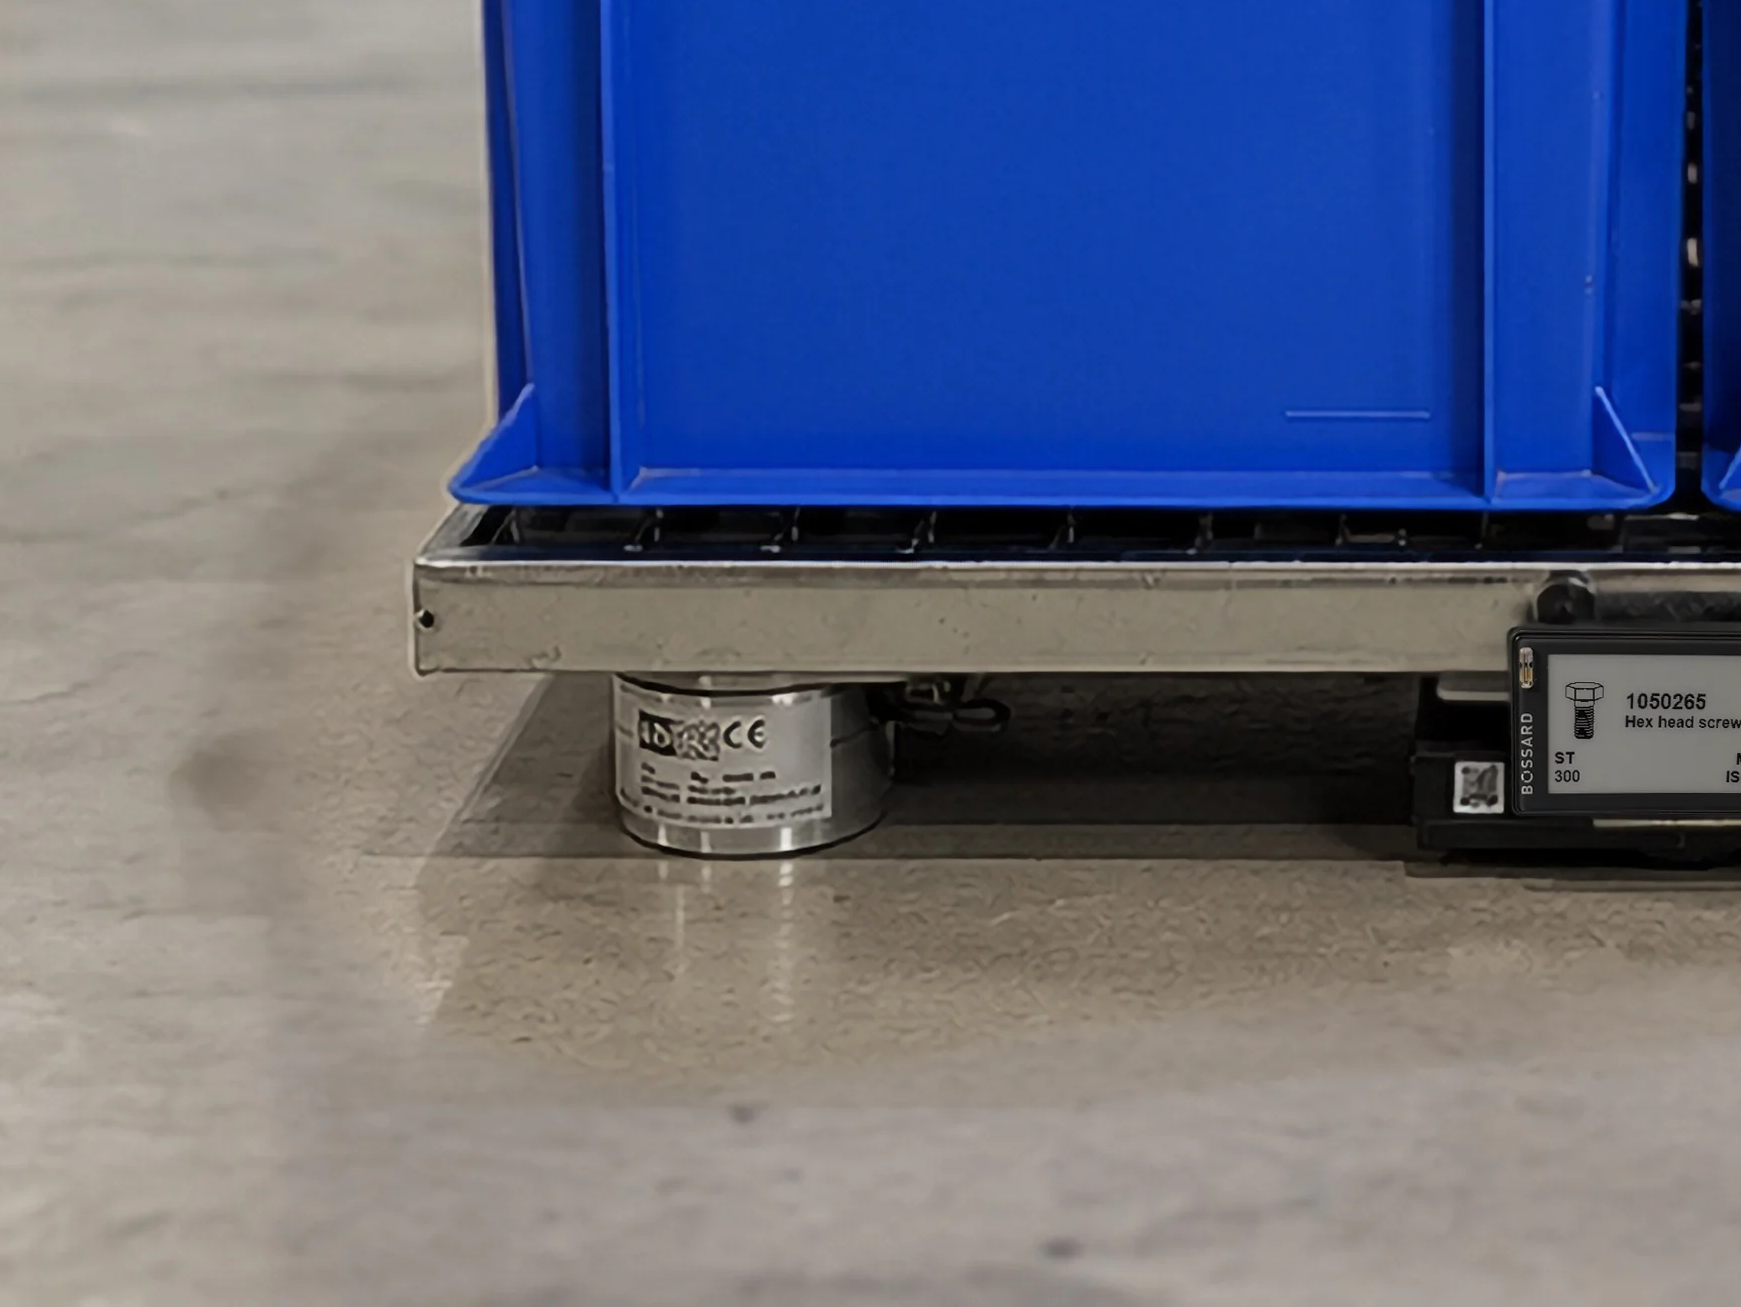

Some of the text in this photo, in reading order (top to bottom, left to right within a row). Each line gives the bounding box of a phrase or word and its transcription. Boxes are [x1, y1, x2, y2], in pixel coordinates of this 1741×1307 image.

[1626, 693, 1707, 710] 1050265
[1625, 715, 1654, 729] Hex
[1658, 715, 1694, 729] head
[1521, 712, 1534, 795] BOSSARD
[1554, 752, 1575, 765] ST
[1554, 770, 1580, 783] 300
